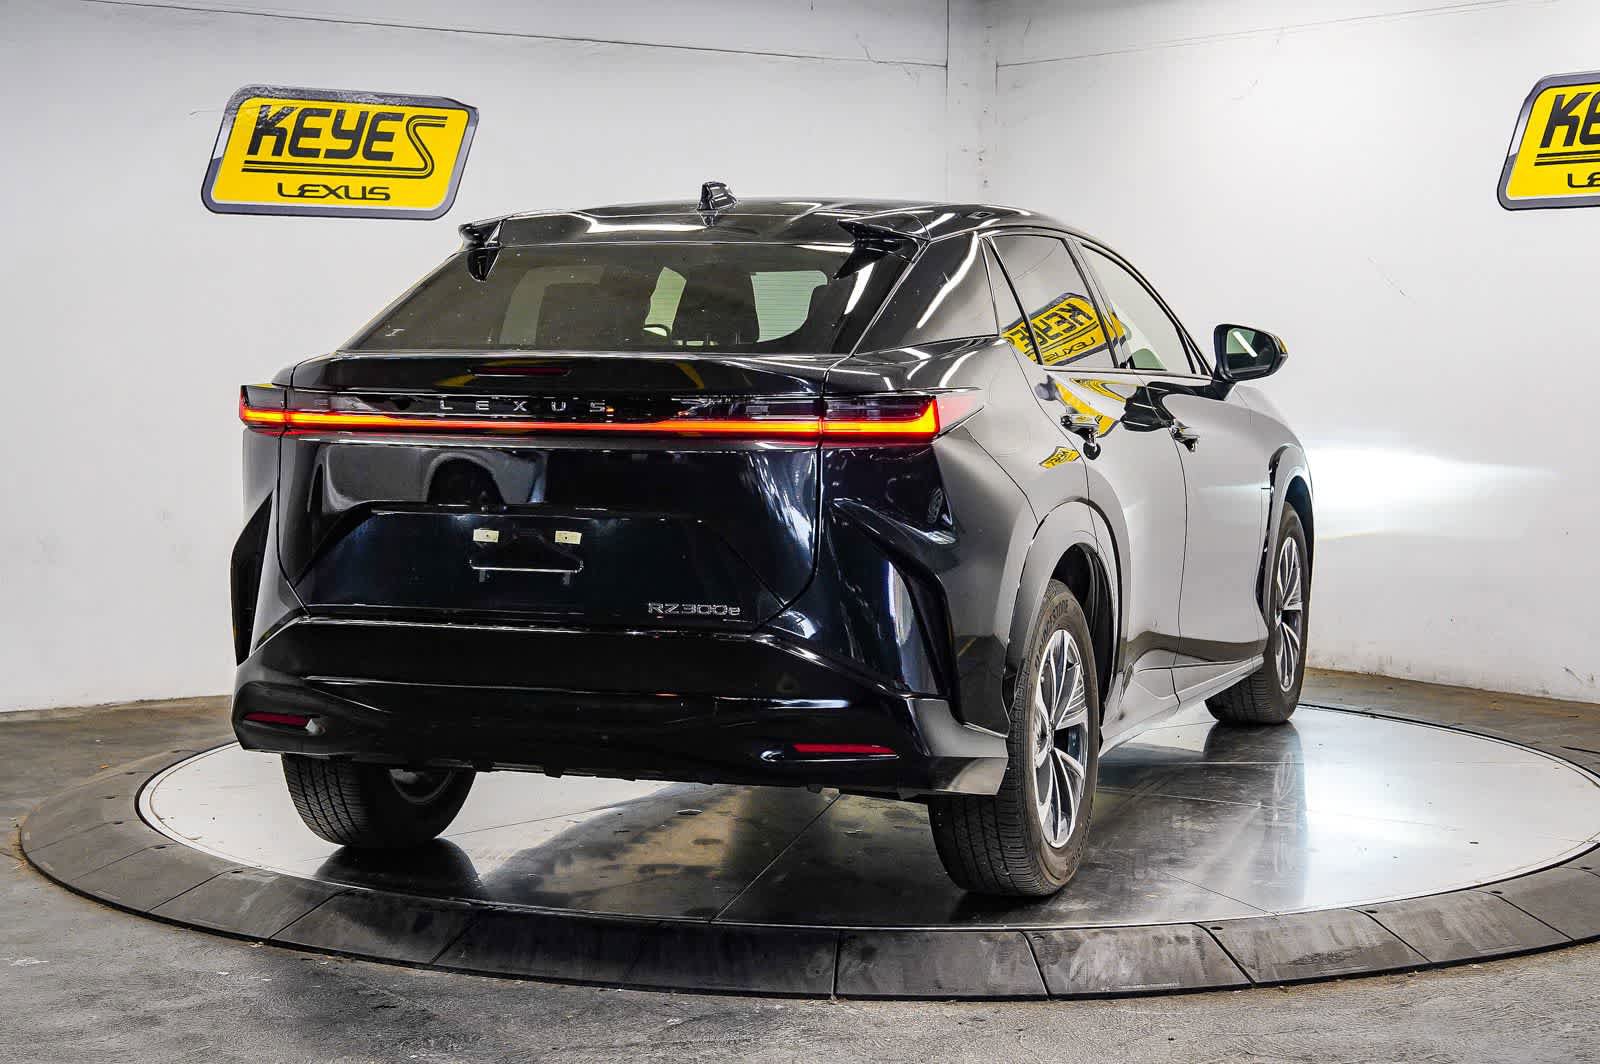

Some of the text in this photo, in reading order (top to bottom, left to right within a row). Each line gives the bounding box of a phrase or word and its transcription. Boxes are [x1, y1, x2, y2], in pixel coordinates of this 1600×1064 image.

[246, 104, 449, 178] KEYES
[277, 182, 391, 201] LEXUS
[439, 399, 606, 413] LEXUS
[647, 602, 741, 616] RZ300e
